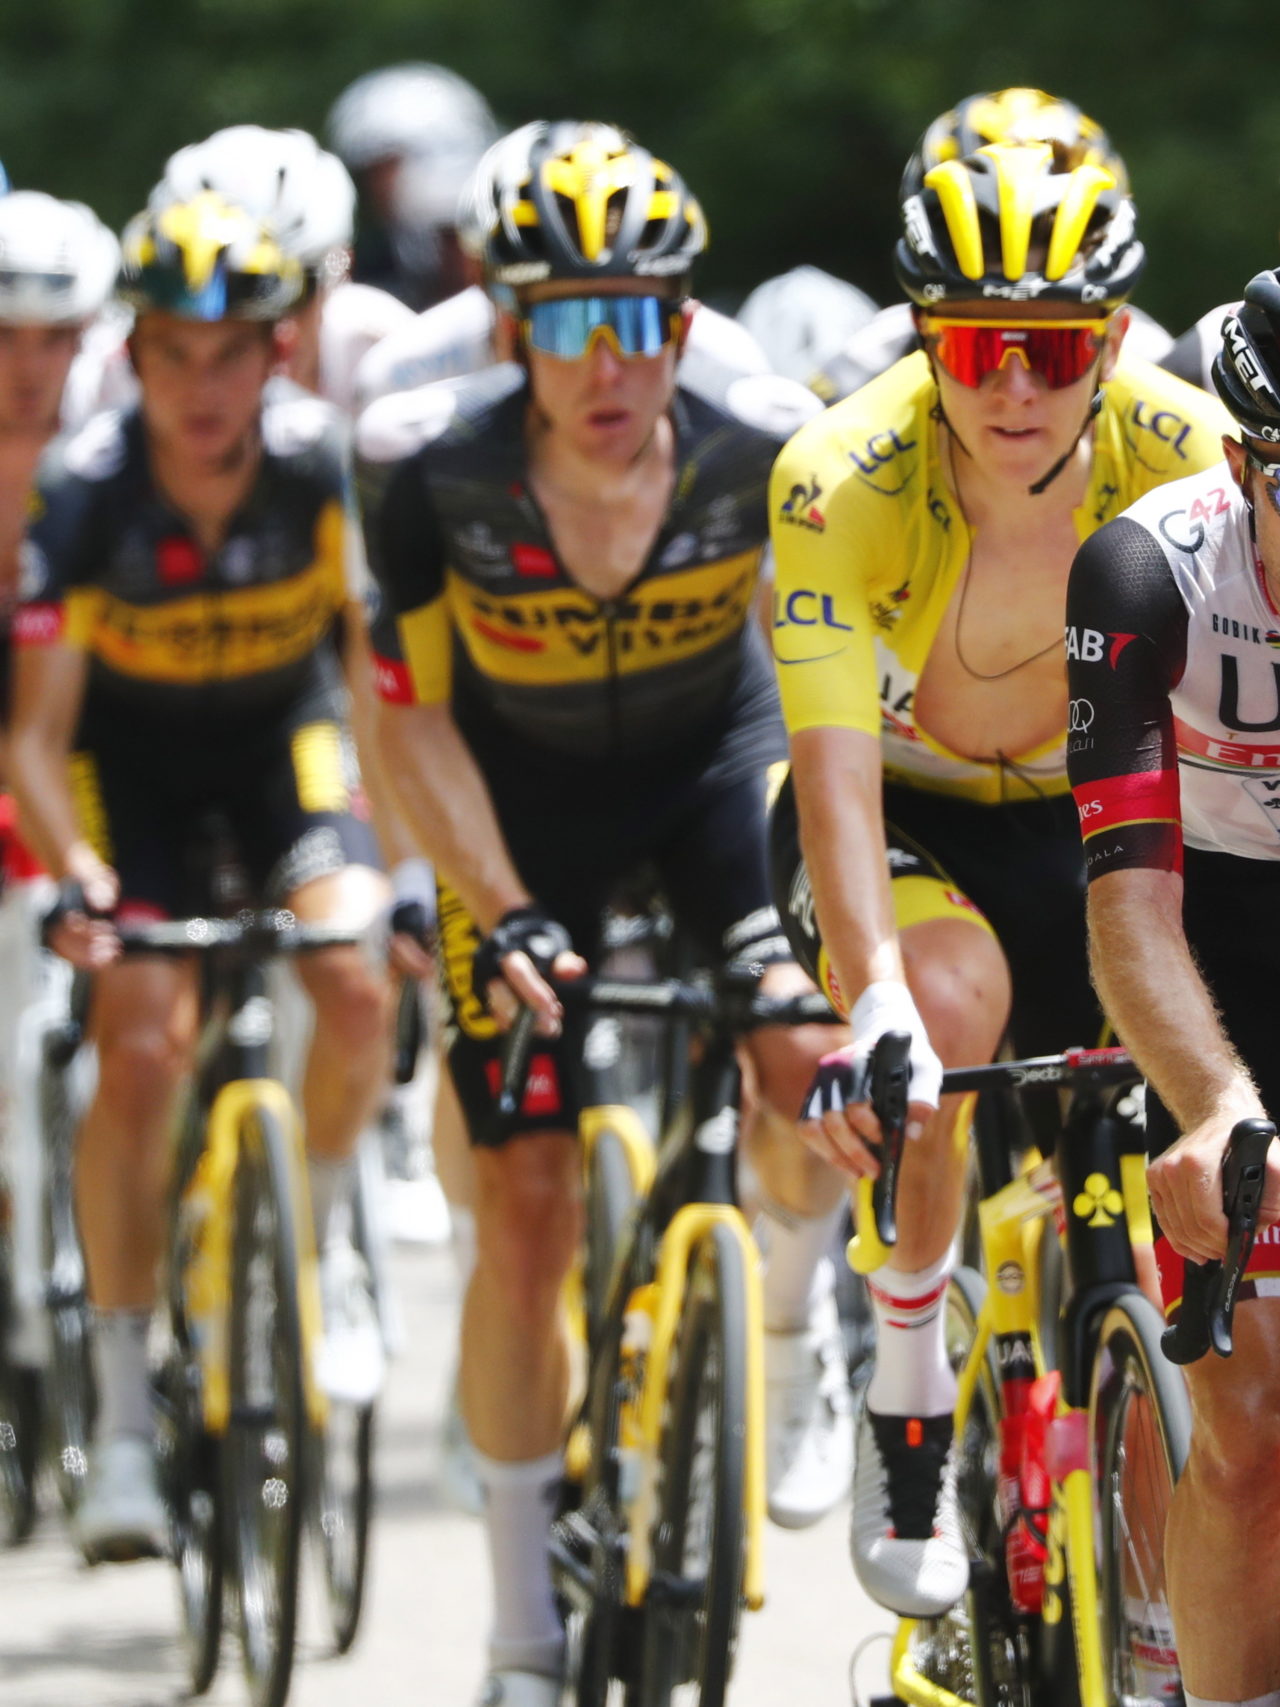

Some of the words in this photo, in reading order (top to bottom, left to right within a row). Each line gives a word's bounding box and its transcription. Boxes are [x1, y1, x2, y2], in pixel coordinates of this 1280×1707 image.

[1224, 318, 1275, 395] MET
[850, 428, 917, 475] LCL
[1132, 400, 1192, 460] LCL
[1158, 487, 1232, 554] G42
[1212, 613, 1261, 644] GOBIK
